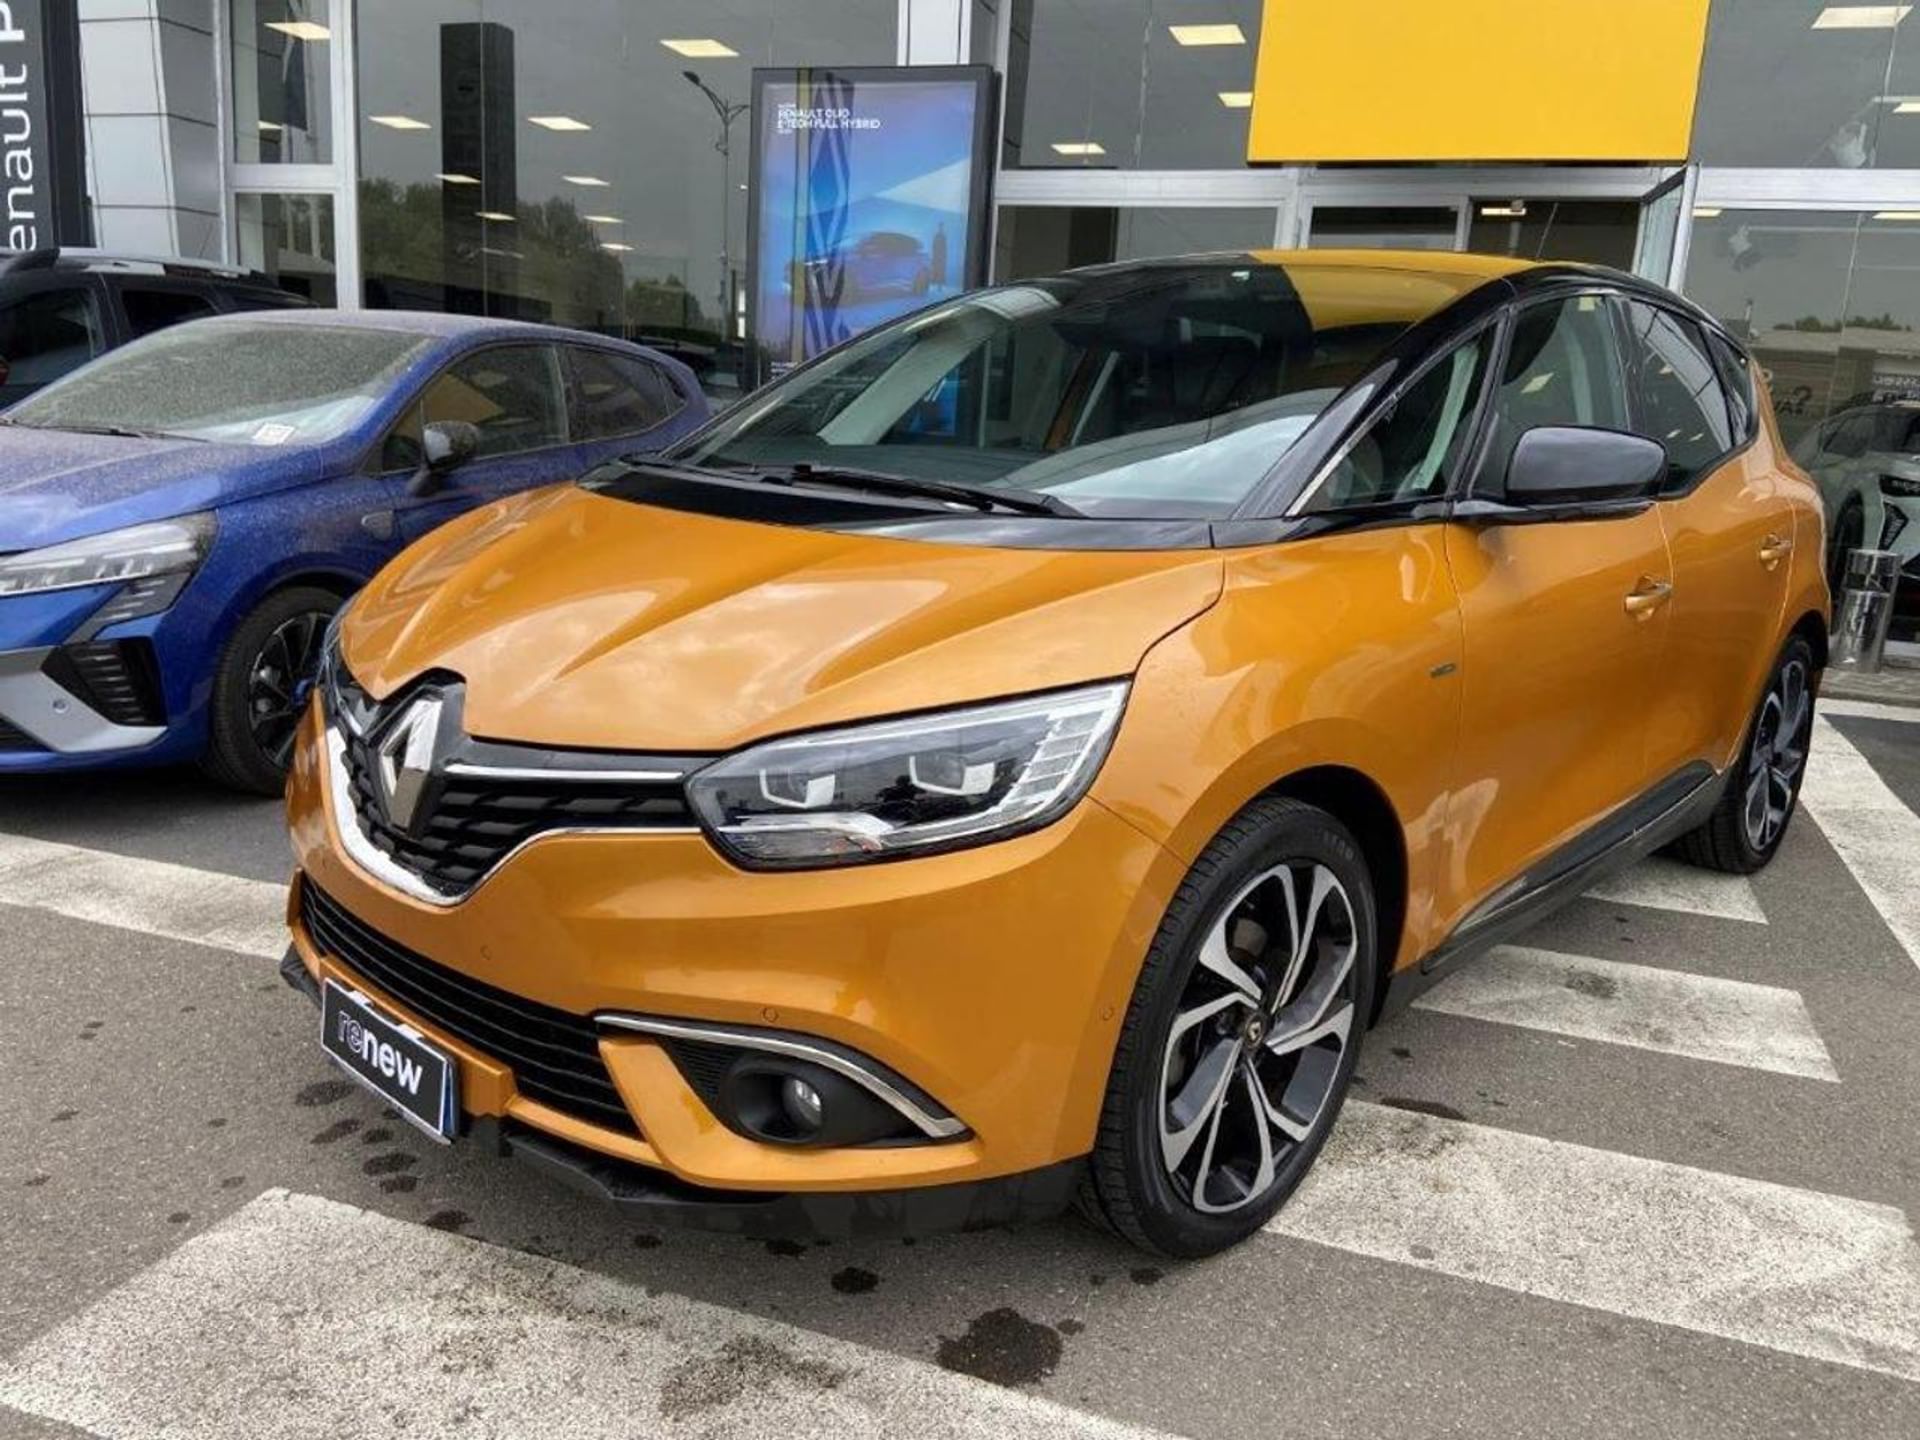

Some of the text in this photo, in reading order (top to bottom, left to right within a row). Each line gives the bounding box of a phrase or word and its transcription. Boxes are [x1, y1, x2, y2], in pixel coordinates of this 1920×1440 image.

[0, 63, 37, 251] enault
[841, 118, 880, 129] HYBRID
[337, 1010, 423, 1095] renew
